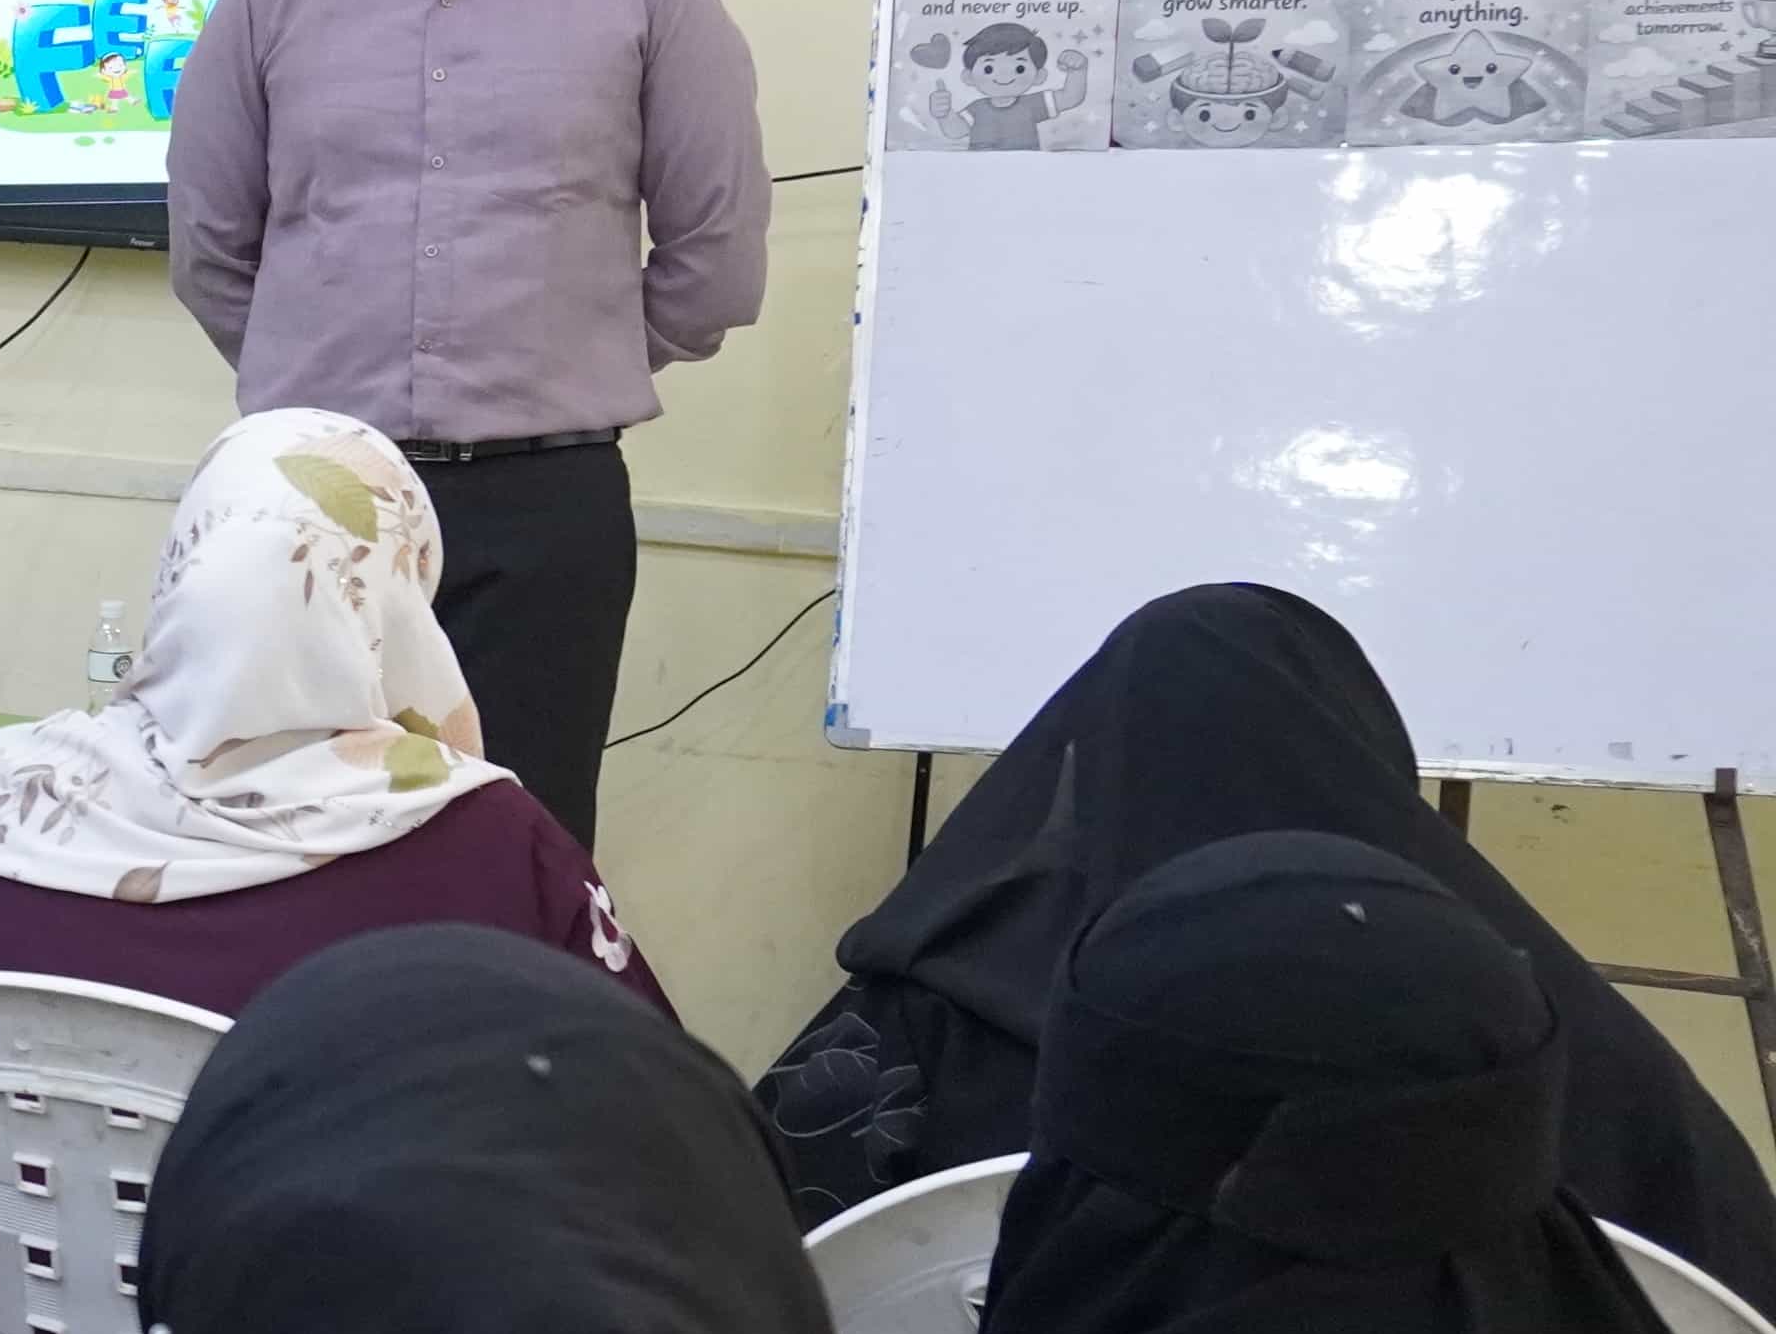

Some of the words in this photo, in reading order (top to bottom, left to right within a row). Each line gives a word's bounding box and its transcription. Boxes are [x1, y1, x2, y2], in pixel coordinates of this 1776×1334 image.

[962, 1, 1011, 14] never
[1057, 2, 1085, 19] up.
[1419, 0, 1529, 29] anything.
[1637, 21, 1728, 36] tomorrow.
